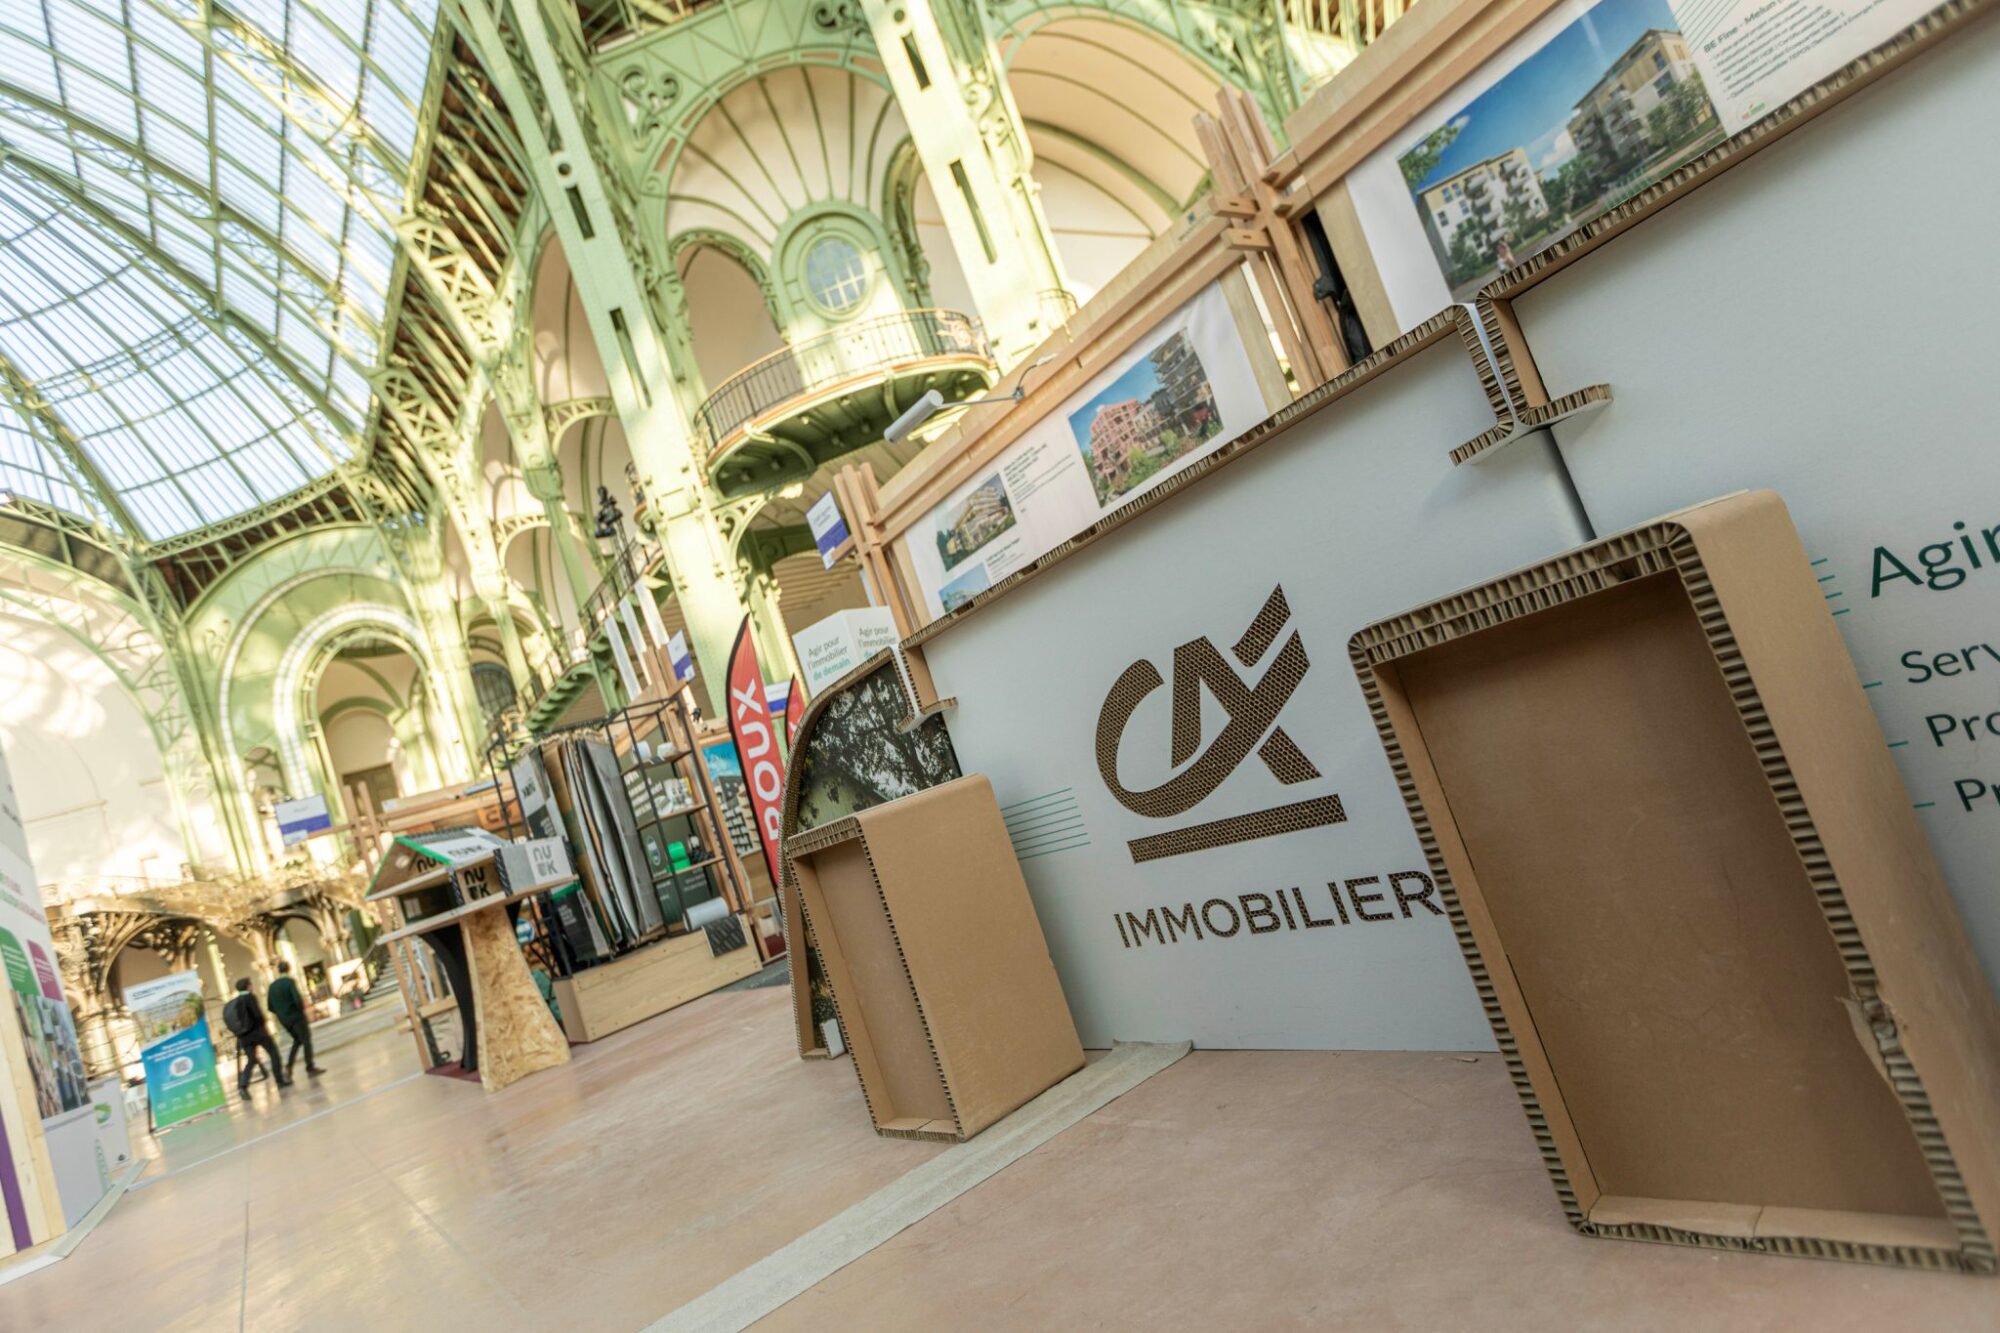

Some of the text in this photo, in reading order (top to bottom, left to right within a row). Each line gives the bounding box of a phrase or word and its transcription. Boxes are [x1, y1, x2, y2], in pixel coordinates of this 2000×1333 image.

[807, 645, 848, 671] l'immobilier
[808, 637, 839, 657] Agir pour
[823, 657, 852, 677] demain
[1114, 871, 1445, 948] IMMOBILIER
